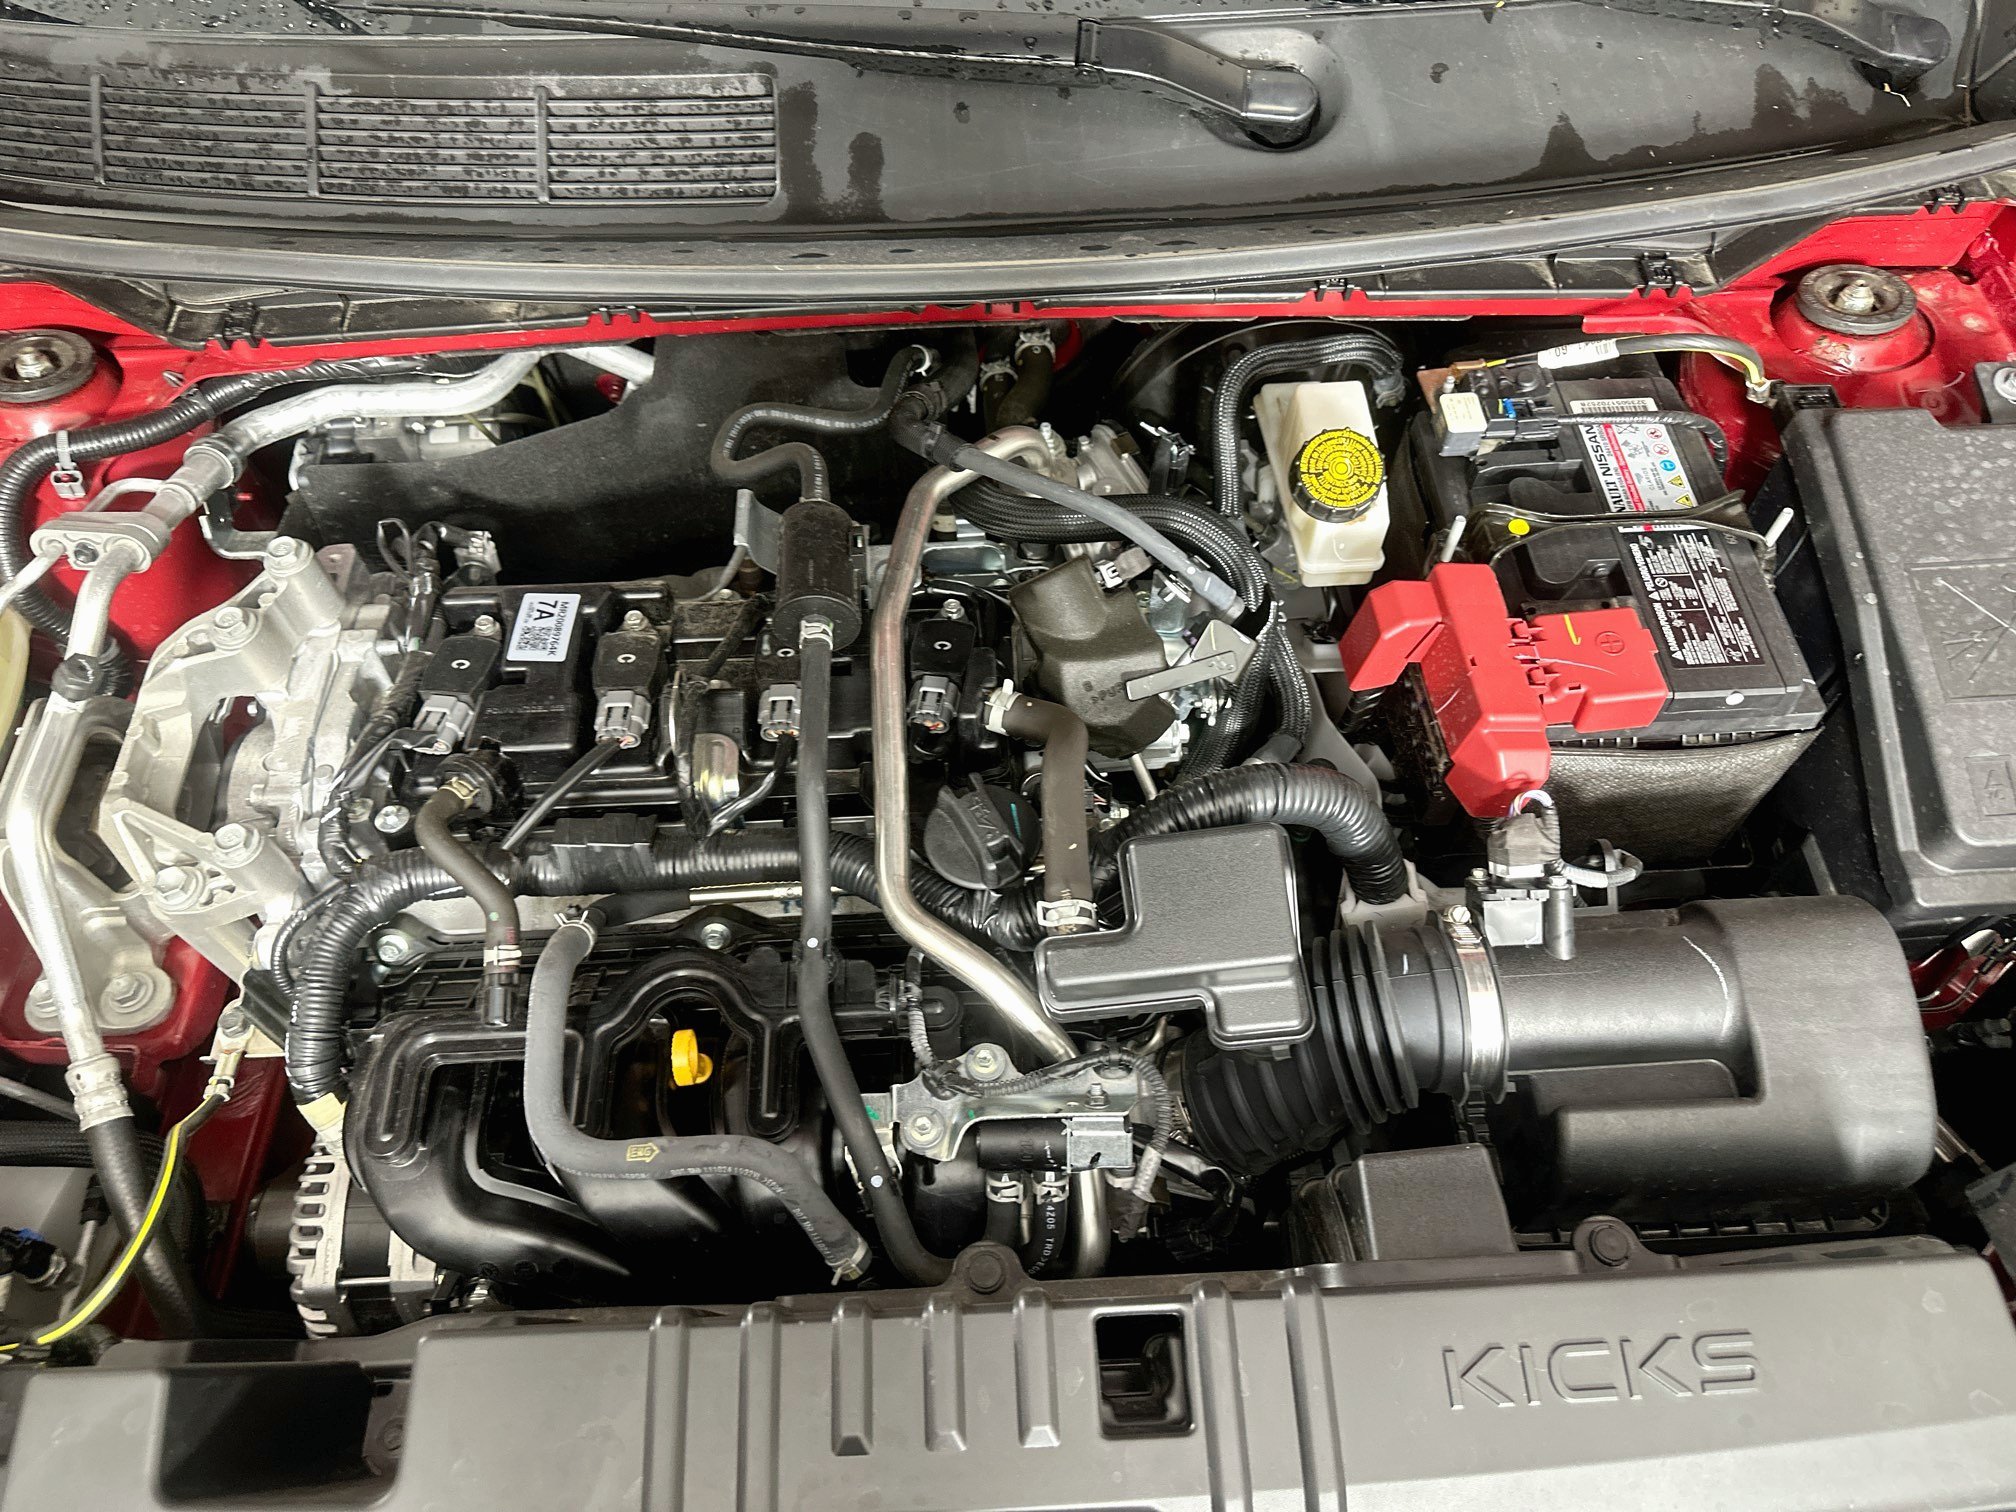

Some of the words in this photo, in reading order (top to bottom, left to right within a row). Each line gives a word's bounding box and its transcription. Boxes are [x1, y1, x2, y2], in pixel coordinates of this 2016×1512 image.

[1584, 424, 1613, 476] NISSAN
[1629, 542, 1655, 592] PELIGRO/VENENO
[533, 600, 558, 621] 7A
[1652, 602, 1680, 652] DANGER/POISON
[1442, 1328, 1758, 1410] KICKS
